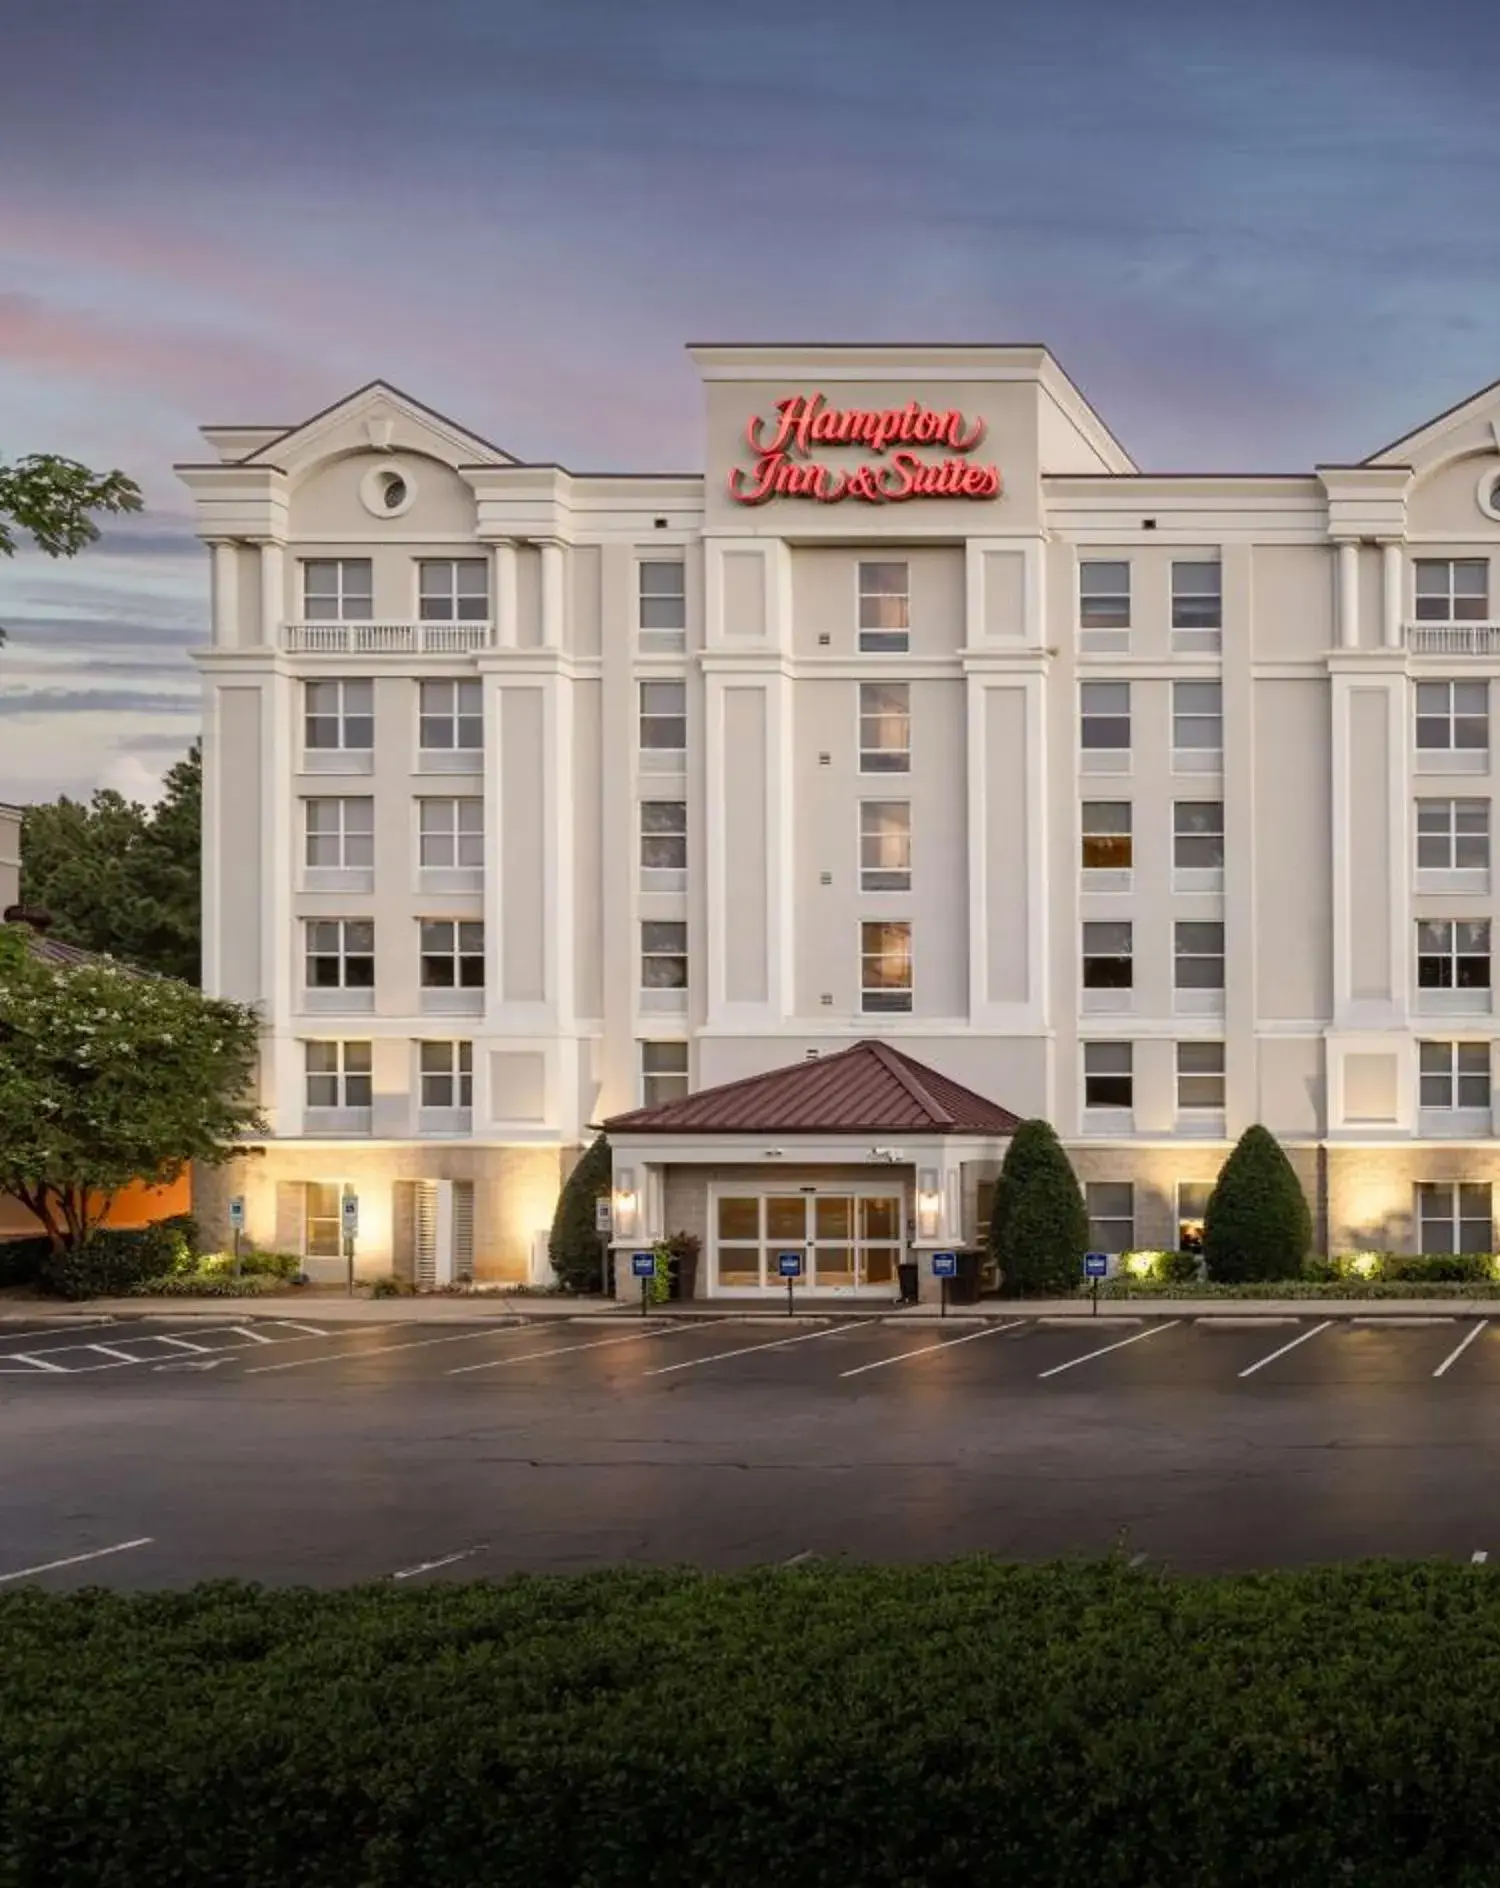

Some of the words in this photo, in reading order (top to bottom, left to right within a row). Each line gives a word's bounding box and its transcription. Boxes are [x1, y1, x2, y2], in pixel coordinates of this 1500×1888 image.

[748, 393, 984, 456] Hampton
[728, 452, 848, 502] Inn
[848, 465, 878, 501] &
[875, 451, 1000, 501] Suites
